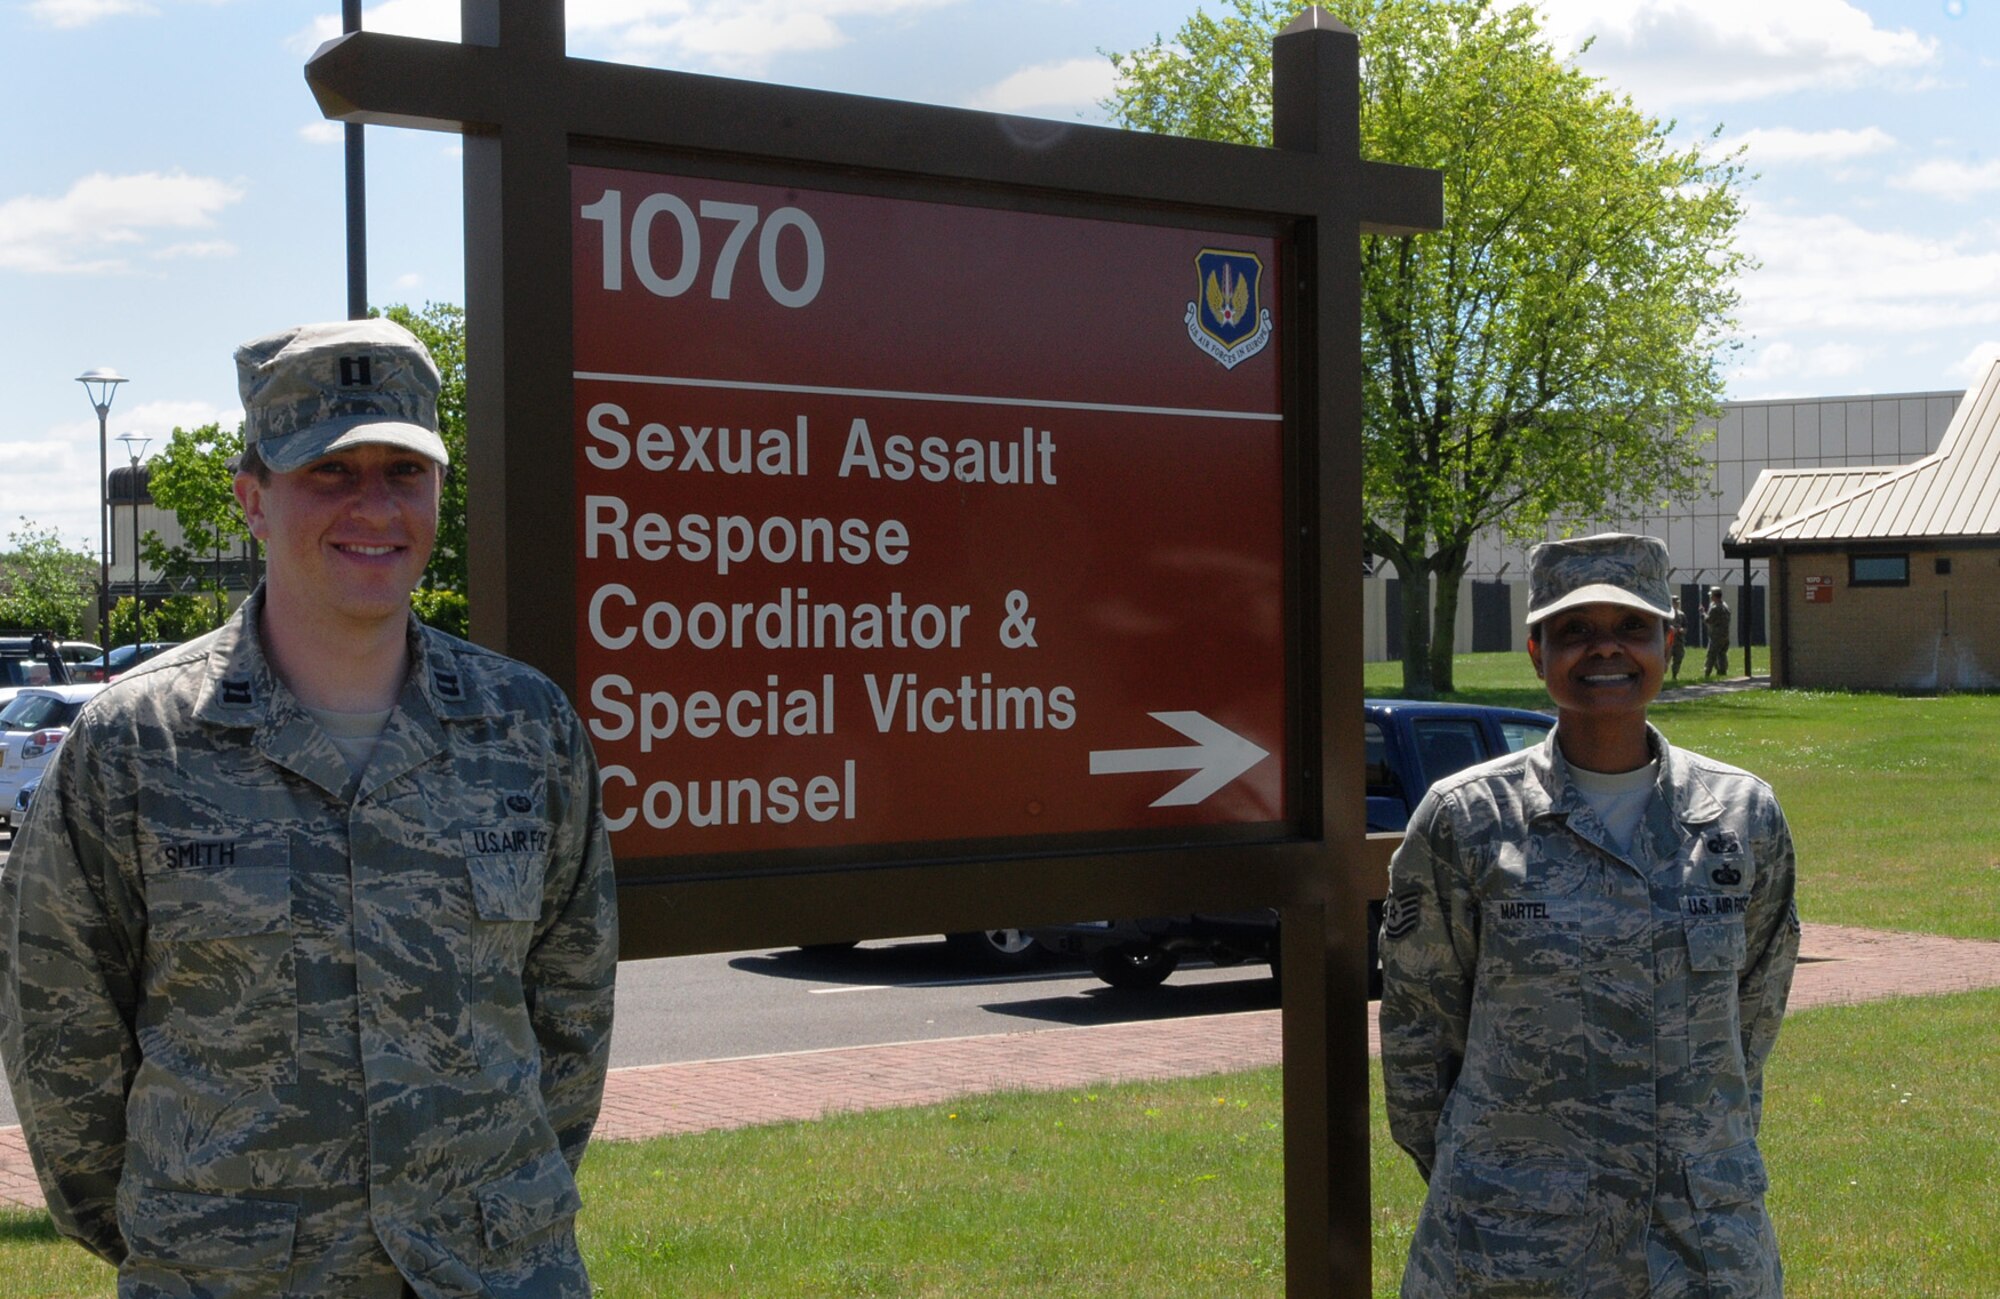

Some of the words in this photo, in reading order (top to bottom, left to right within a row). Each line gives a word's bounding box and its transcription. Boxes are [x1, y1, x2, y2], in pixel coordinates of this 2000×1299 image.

[581, 189, 825, 308] 1070
[1198, 335, 1210, 349] AIR
[1211, 344, 1237, 364] FORCES
[1236, 348, 1246, 358] IN
[1245, 328, 1268, 353] EUROPE
[585, 403, 808, 480] Sexual
[838, 418, 1057, 485] Assault
[585, 495, 910, 575] Response
[588, 583, 971, 650] Coordinator
[999, 589, 1038, 649] &
[588, 674, 835, 753] Special
[863, 673, 1077, 733] Victims
[599, 759, 856, 832] Counsel
[165, 842, 235, 869] SMITH
[1501, 902, 1550, 920] MARTEL
[1716, 897, 1734, 914] AIR
